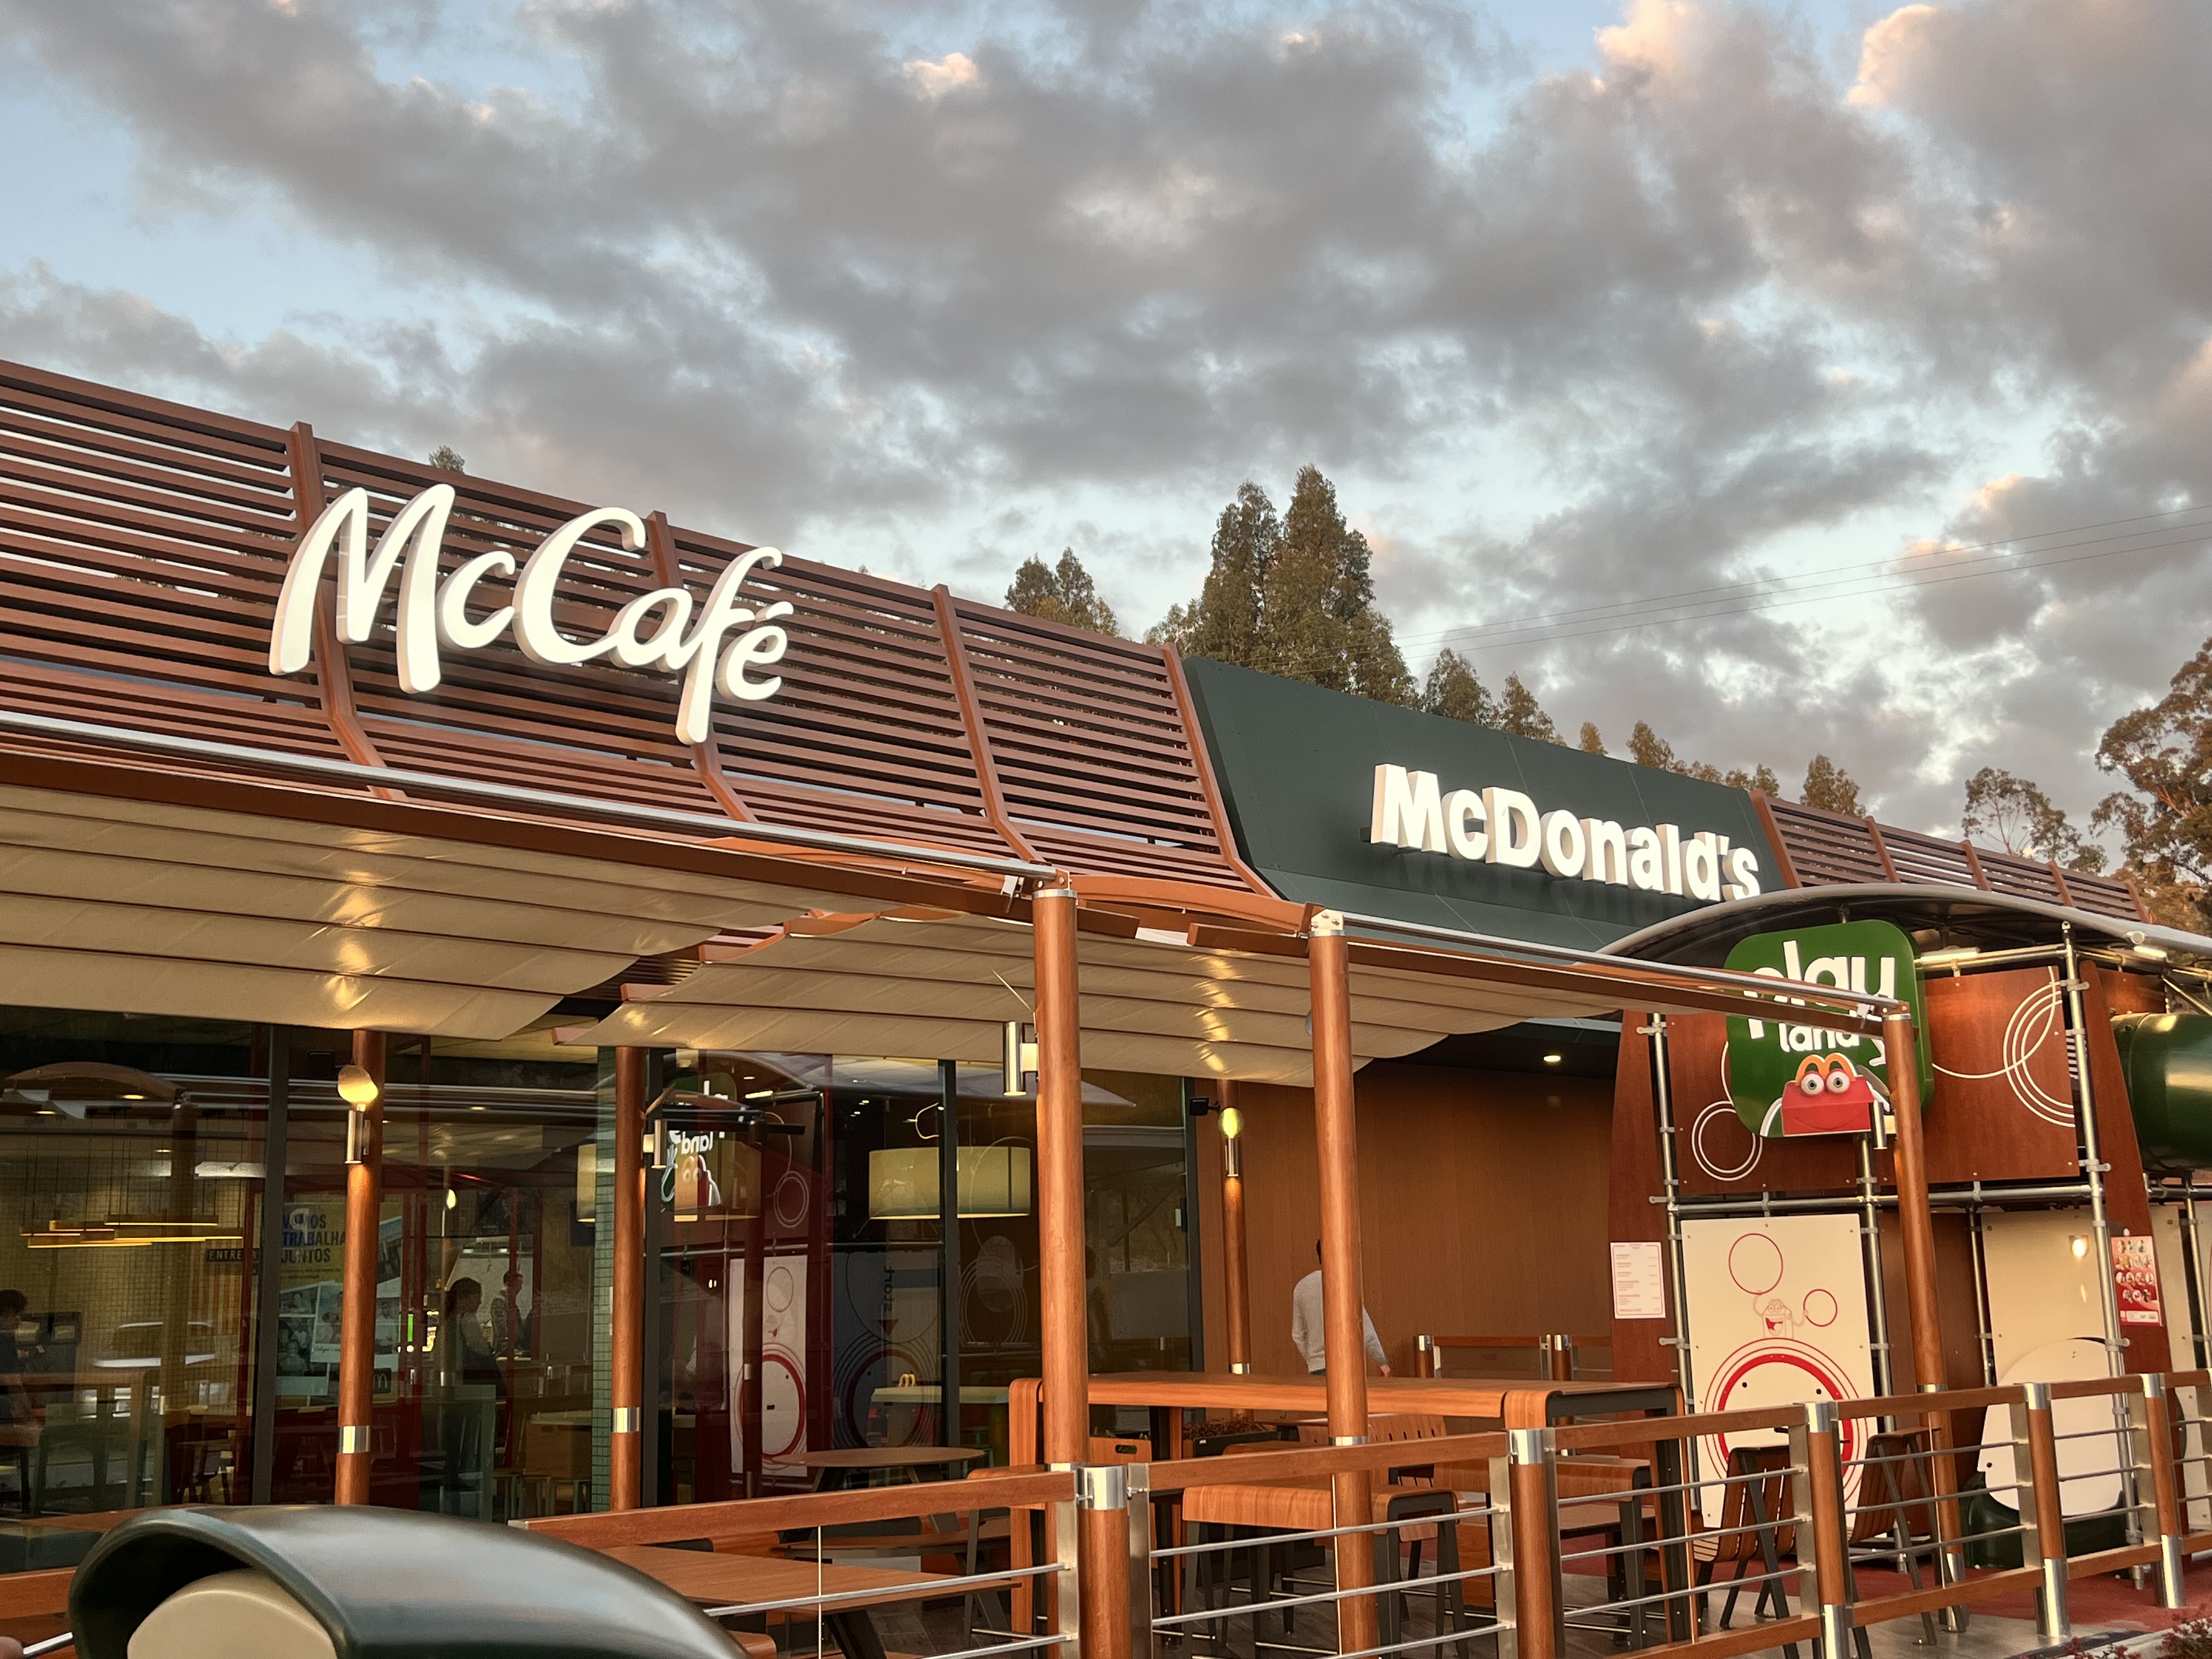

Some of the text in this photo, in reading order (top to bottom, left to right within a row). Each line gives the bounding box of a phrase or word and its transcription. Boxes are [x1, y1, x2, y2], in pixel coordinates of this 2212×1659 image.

[269, 483, 794, 745] McCafé
[1370, 763, 1760, 901] McDonald's
[280, 1248, 331, 1263] JUNTOS
